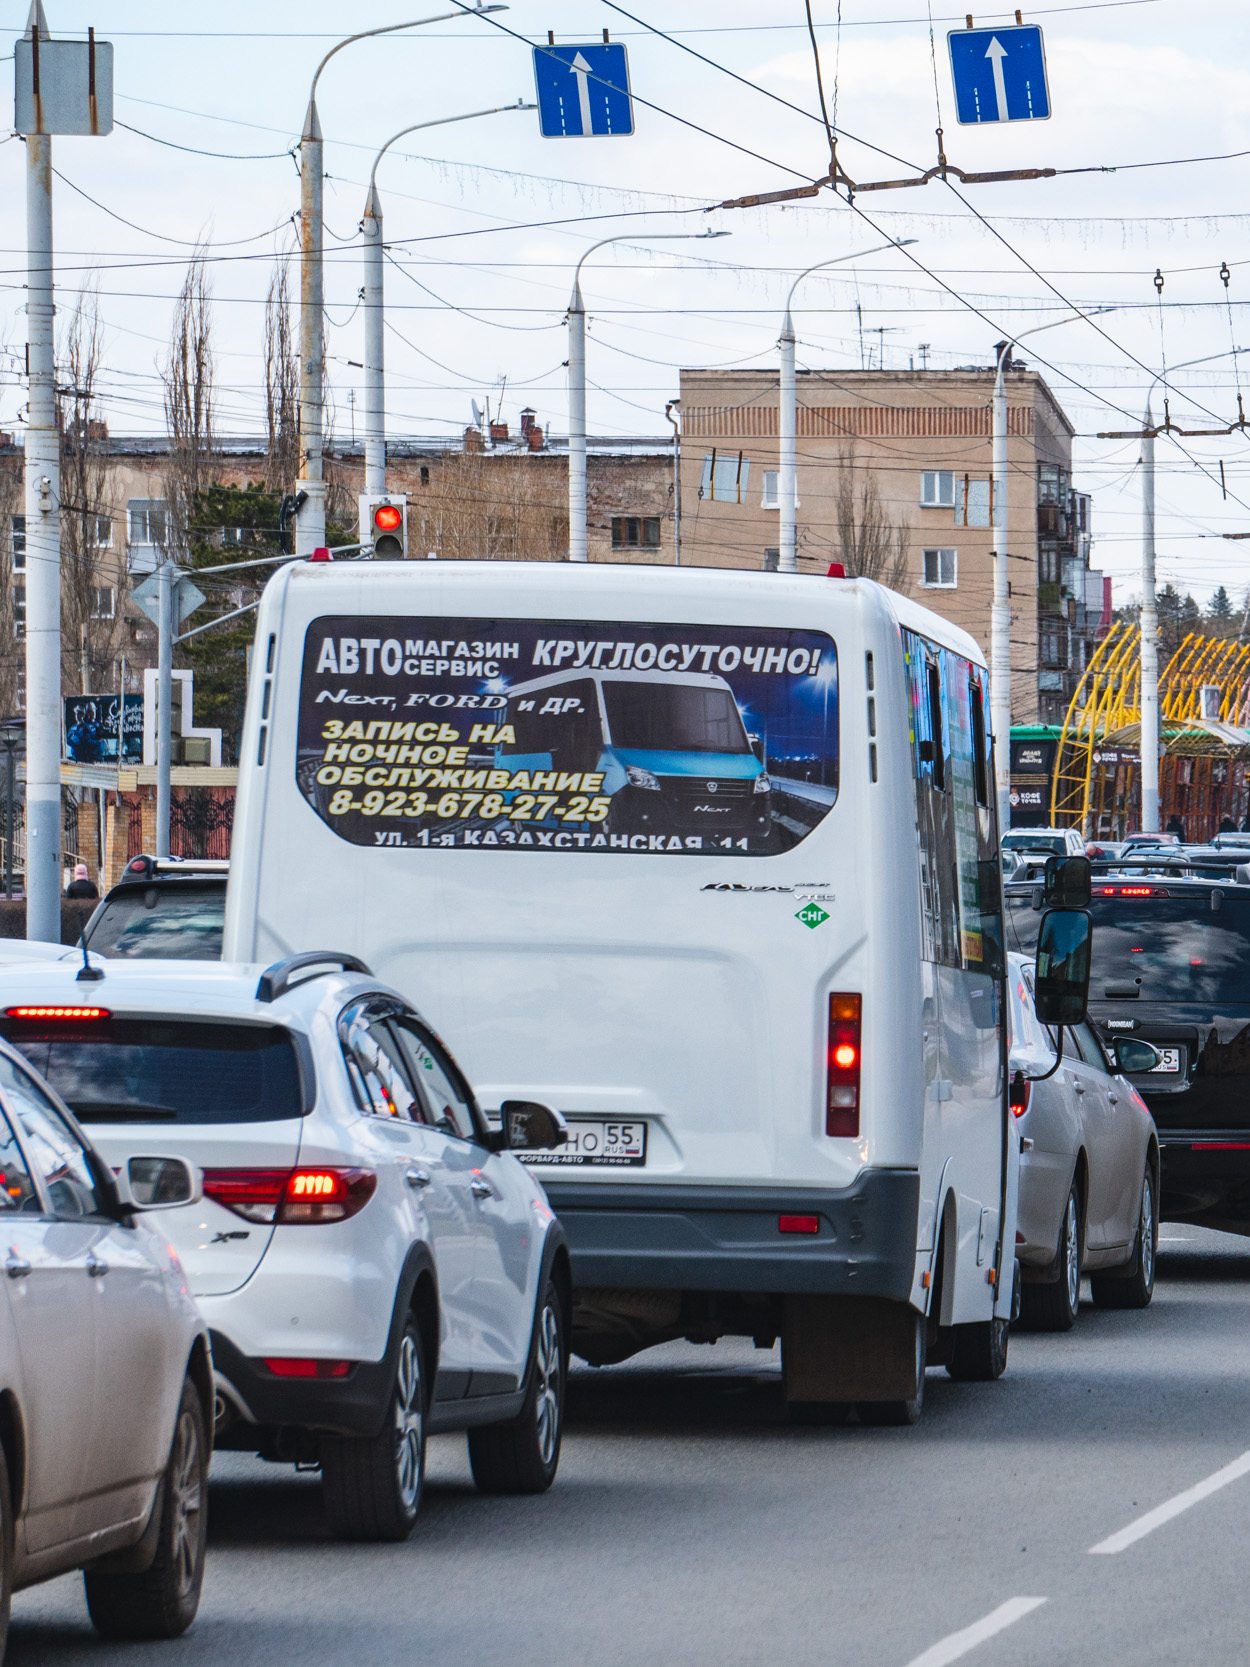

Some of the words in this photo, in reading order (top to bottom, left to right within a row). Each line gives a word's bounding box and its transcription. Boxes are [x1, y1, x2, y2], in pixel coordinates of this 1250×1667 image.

[315, 637, 403, 676] АВТО
[403, 640, 520, 659] МАГАЗИН
[532, 640, 822, 676] КРУГЛОСУТОЧНО!
[403, 659, 500, 678] СЕРВИС
[403, 693, 510, 709] FORD
[539, 697, 585, 715] ДР.
[321, 720, 460, 742] ЗАПИСЬ
[468, 724, 516, 744] НА
[322, 743, 470, 766] НОЧНОЕ
[315, 766, 604, 793] ОБСЛУЖИВАНИЕ
[327, 789, 612, 822] 8-923-678-27-25
[463, 829, 703, 850] КАЗАХСТАНСКАЯ
[798, 910, 825, 922] СНГ
[607, 1126, 633, 1145] 55
[604, 1145, 625, 1154] RUS
